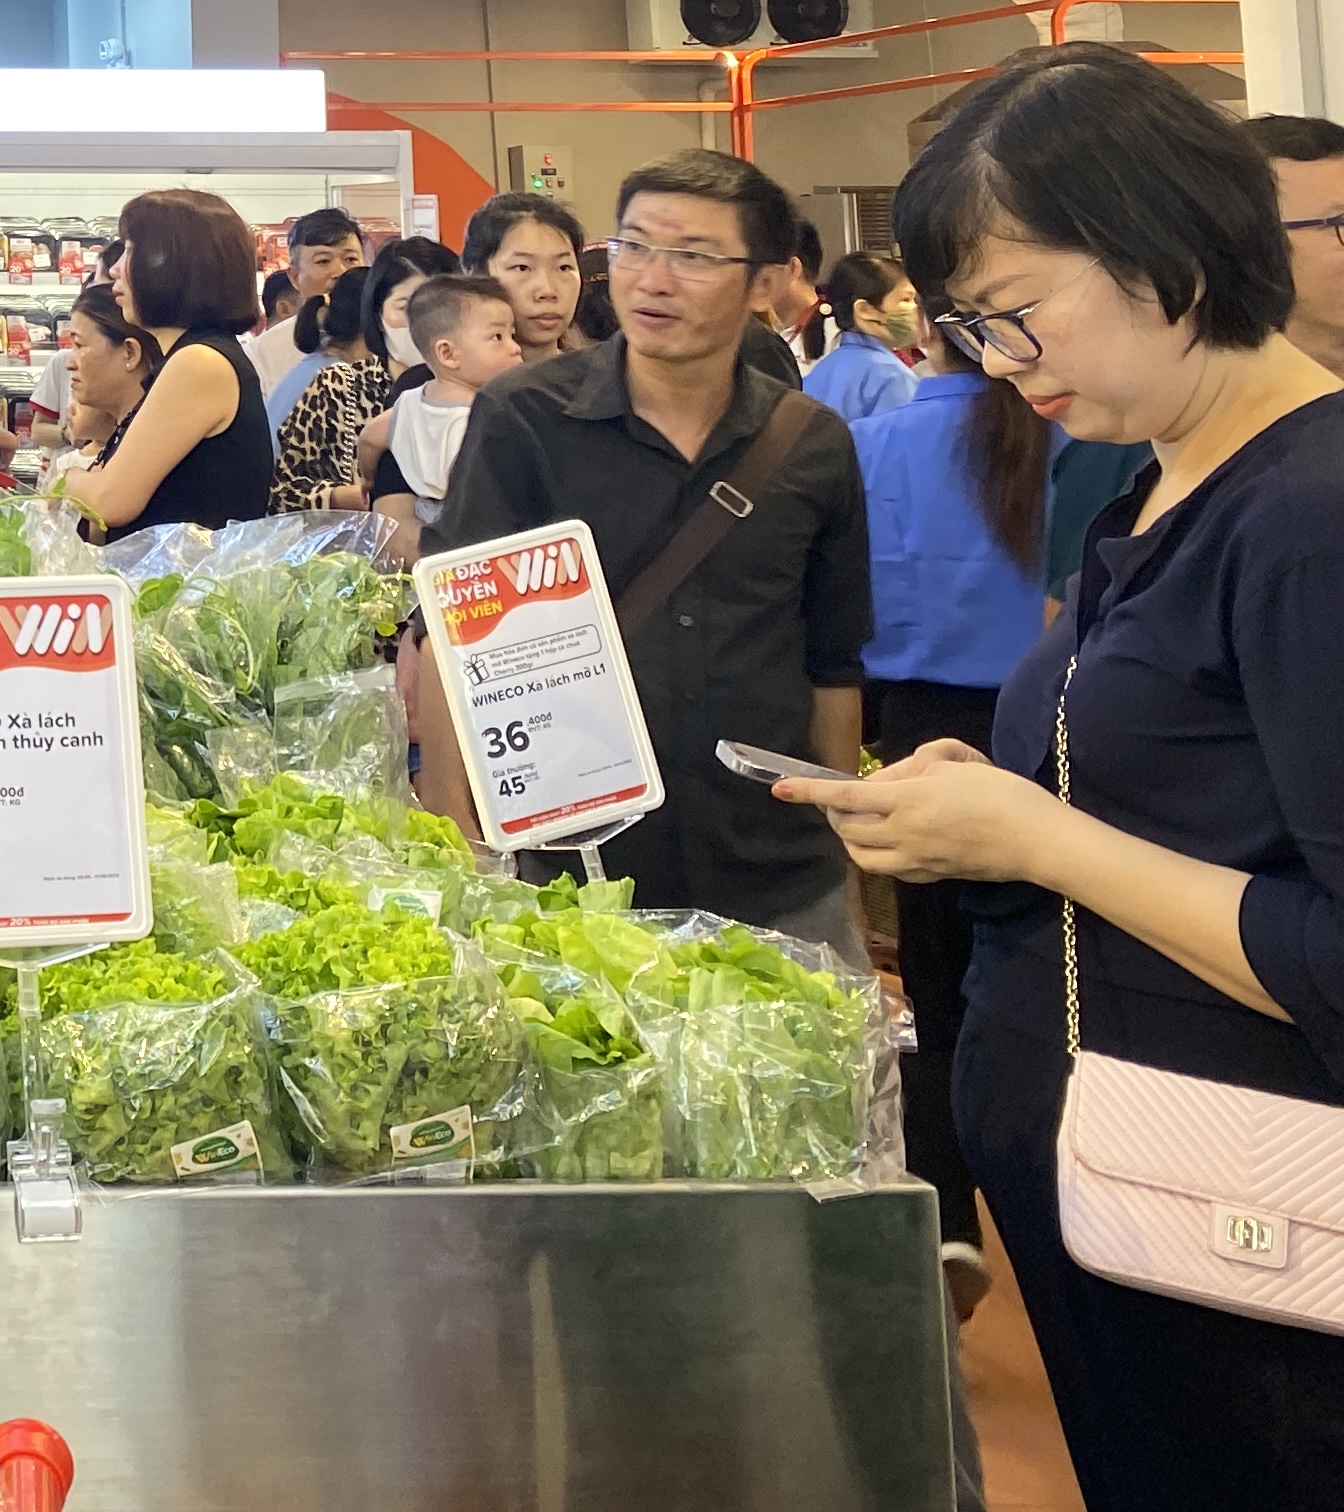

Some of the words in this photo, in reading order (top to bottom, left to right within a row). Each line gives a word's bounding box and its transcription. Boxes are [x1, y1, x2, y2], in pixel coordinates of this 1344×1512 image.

[455, 559, 492, 582] ĐẶC
[469, 599, 503, 620] VIÊN
[472, 685, 524, 707] WINECO
[526, 678, 544, 694] Xà
[545, 672, 571, 688] lách
[593, 662, 606, 675] L1
[7, 712, 32, 729] Xà
[38, 711, 76, 728] lách
[13, 732, 54, 752] thủy
[60, 732, 104, 747] canh
[481, 720, 530, 759] 36
[499, 775, 526, 798] 45
[10, 917, 31, 926] 20%
[194, 1146, 236, 1163] WinEco
